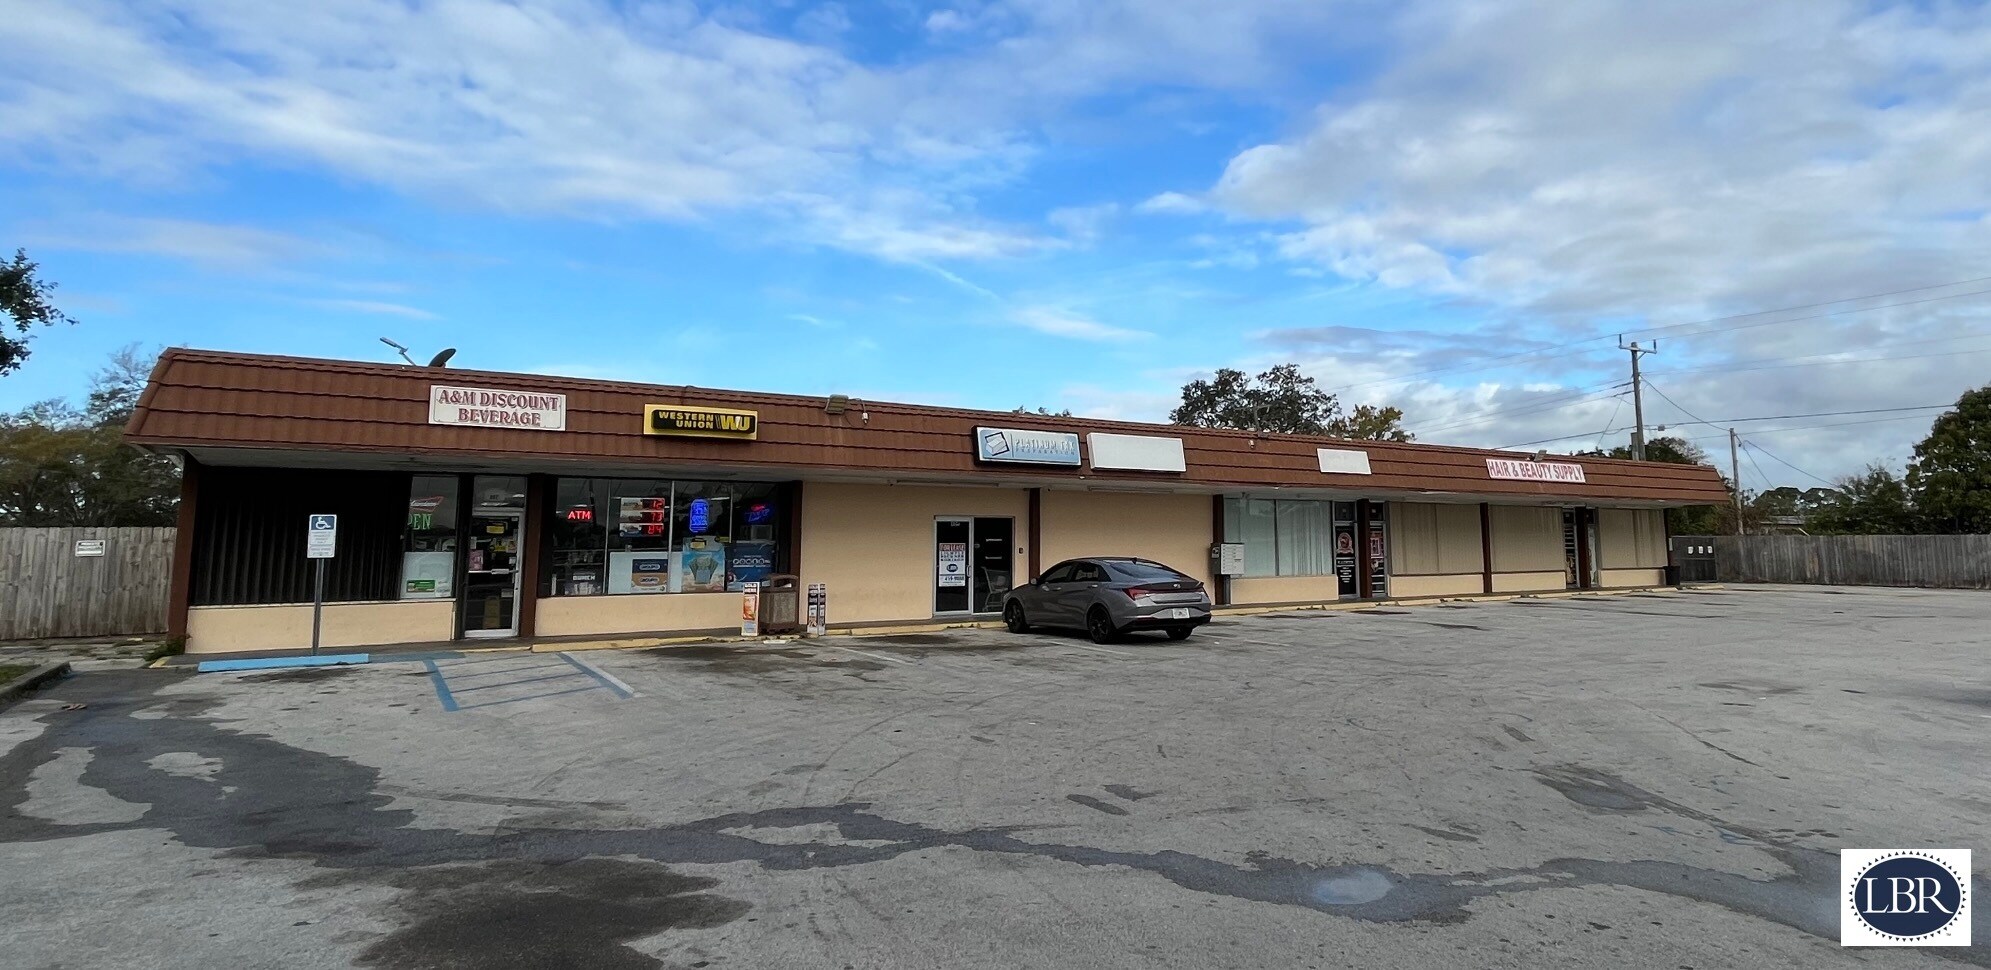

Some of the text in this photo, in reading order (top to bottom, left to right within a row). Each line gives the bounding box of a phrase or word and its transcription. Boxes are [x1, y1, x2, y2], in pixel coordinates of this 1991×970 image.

[438, 389, 559, 411] A&M DISCOUNT
[457, 408, 541, 427] BEVERAGE
[658, 411, 714, 422] WESTERN
[675, 420, 714, 429] UNION
[720, 415, 751, 431] WU
[1487, 460, 1584, 481] HAIR & BEAUTY SUPPLY
[567, 510, 592, 520] ATM
